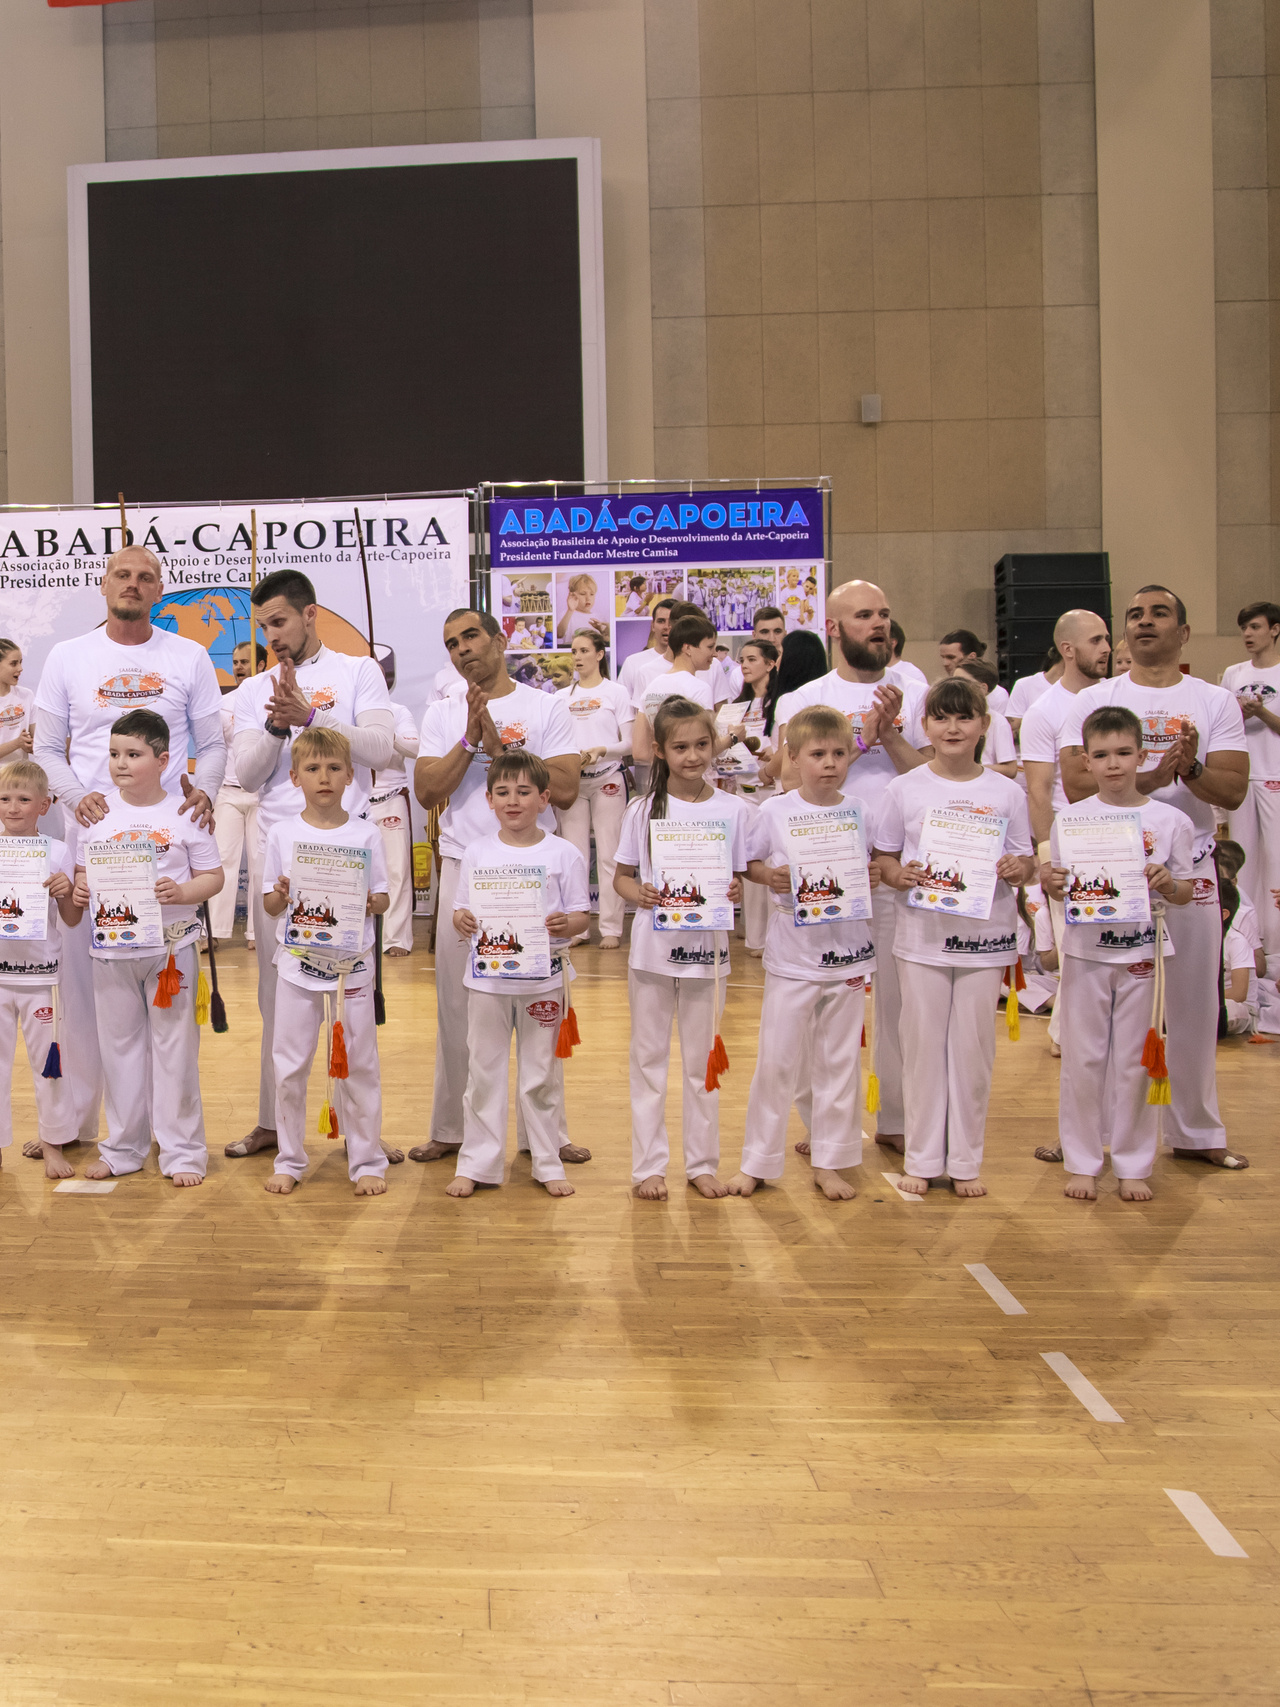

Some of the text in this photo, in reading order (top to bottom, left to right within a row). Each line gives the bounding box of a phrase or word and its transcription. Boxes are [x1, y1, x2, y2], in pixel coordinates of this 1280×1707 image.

[499, 499, 810, 535] ABADÁ-CAPOEIRA
[0, 516, 451, 558] ABADÁ-CAPOEIRA
[500, 539, 550, 549] Associação
[552, 537, 595, 547] Brasileira
[597, 536, 609, 545] de
[611, 536, 639, 547] Apoio
[649, 533, 730, 544] Desenvolvimento
[731, 532, 743, 541] da
[745, 531, 809, 542] Arte-Capoeira
[0, 560, 69, 573] Associação
[74, 557, 108, 570] Brasi
[161, 556, 199, 570] Apoio
[204, 558, 210, 566] e
[336, 551, 351, 562] da
[500, 547, 679, 562] Presidente Fundador: Mestre Camisa
[0, 573, 80, 589] Presidente
[168, 570, 222, 584] Mestre
[226, 568, 273, 582] Cami
[102, 690, 160, 698] ABADÁ-CAPOEIRA
[790, 823, 858, 837] CERTIFICADO
[930, 819, 1000, 837] CERTIFICADO
[656, 833, 726, 842] CERTIFICADO
[90, 855, 152, 865] CERTIFICADO
[297, 856, 365, 870] CERTIFICADO
[474, 881, 541, 890] CERTIFICADO
